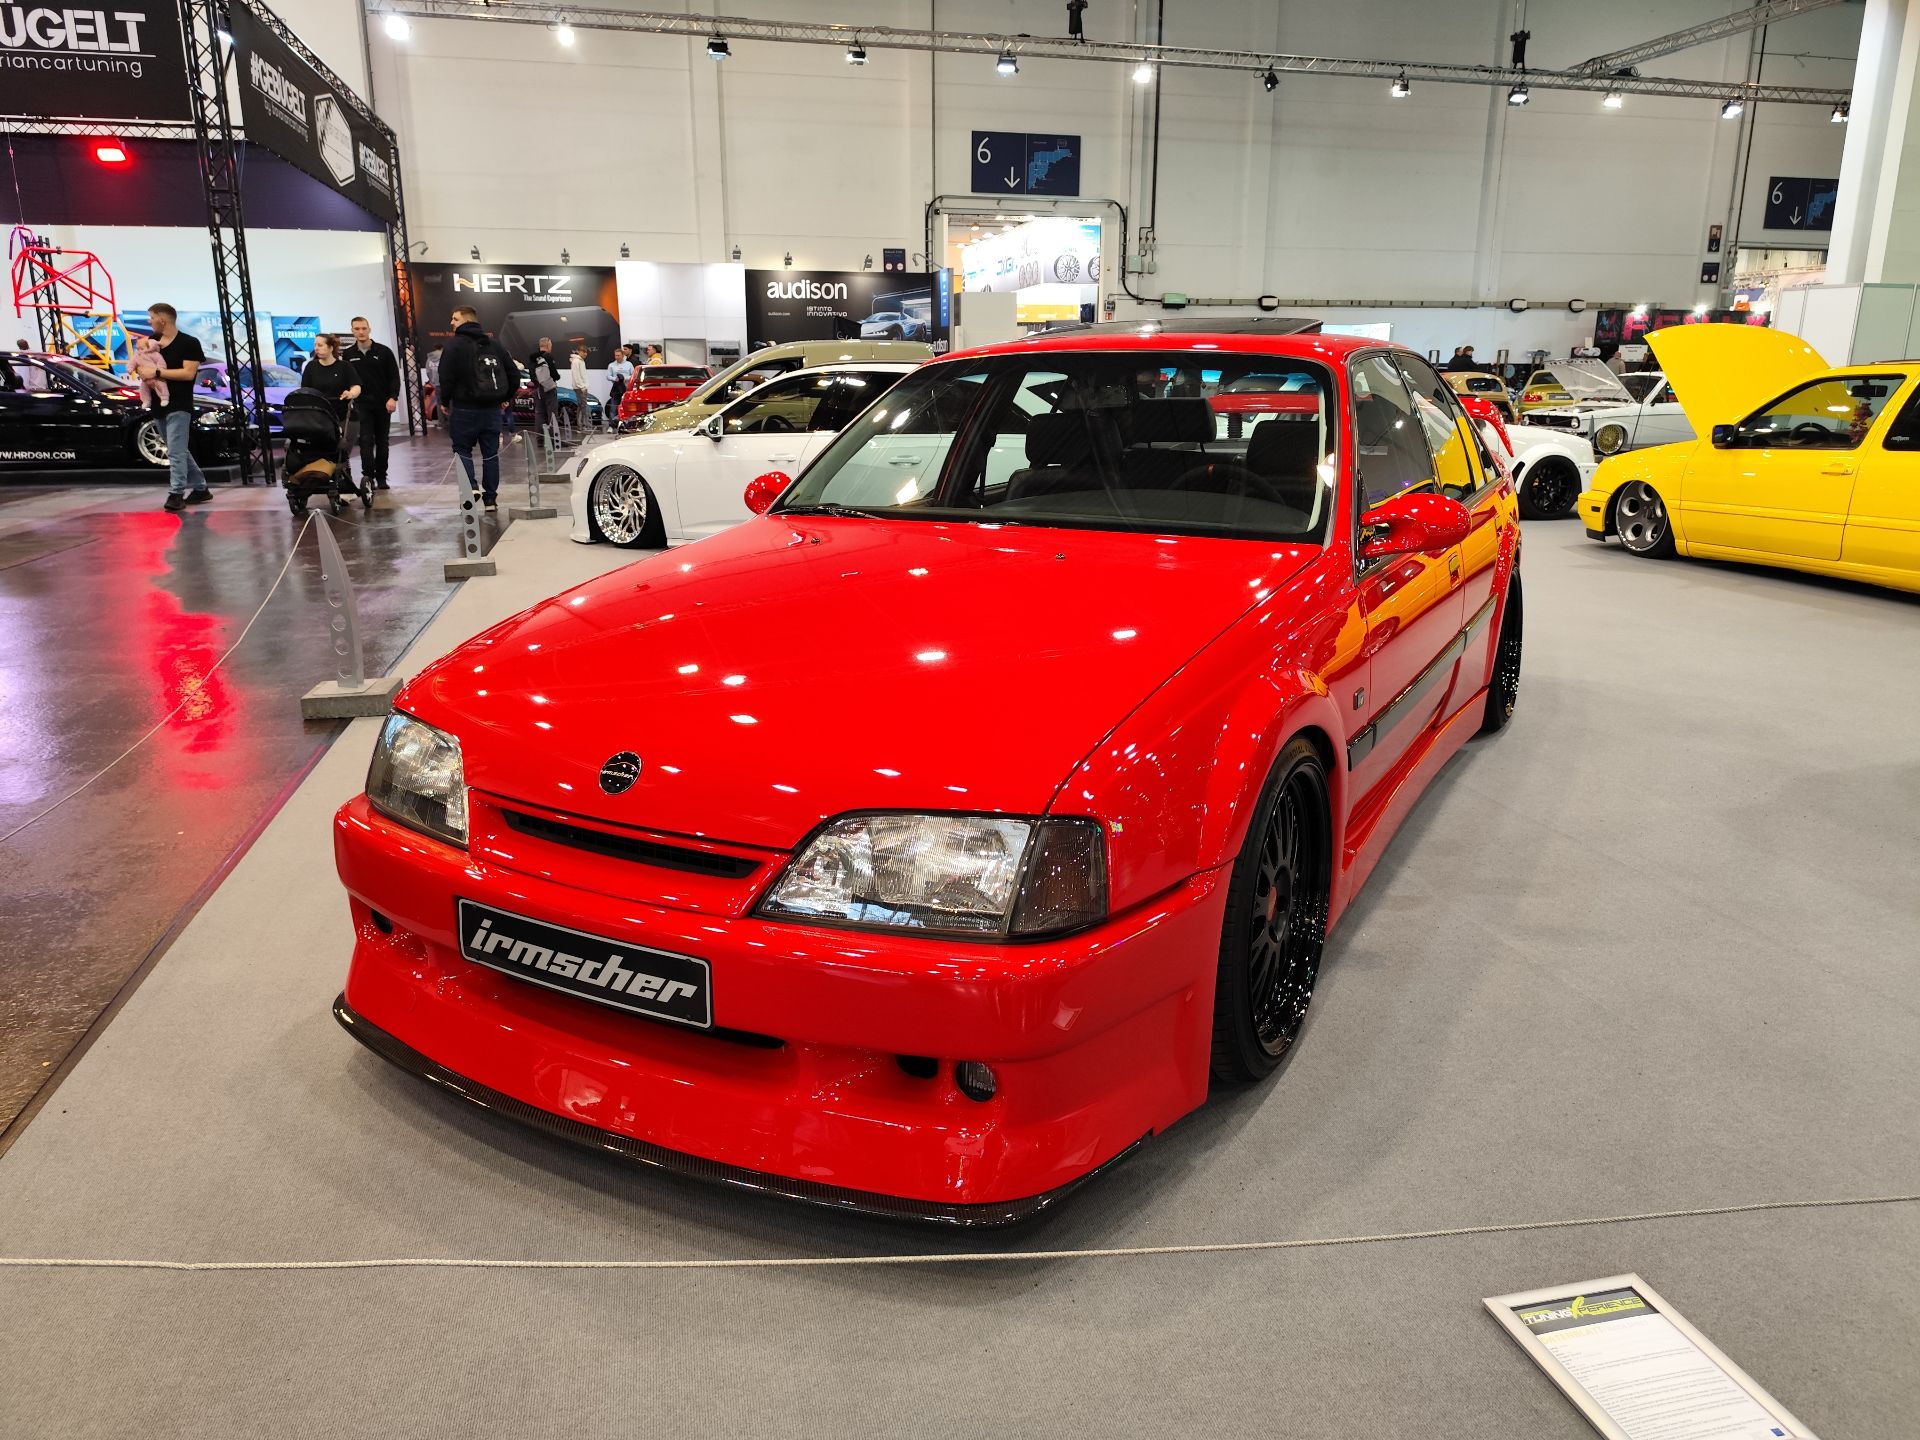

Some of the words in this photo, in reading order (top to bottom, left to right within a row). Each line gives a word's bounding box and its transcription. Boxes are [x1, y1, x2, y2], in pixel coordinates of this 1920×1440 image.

[250, 50, 307, 123] #GEBÜGELT
[977, 136, 992, 164] 6
[1771, 181, 1783, 205] 6
[452, 273, 572, 295] HERTZ
[766, 279, 848, 300] audison
[469, 918, 699, 1003] irmscher
[1541, 1326, 1605, 1345] DATENBLATT
